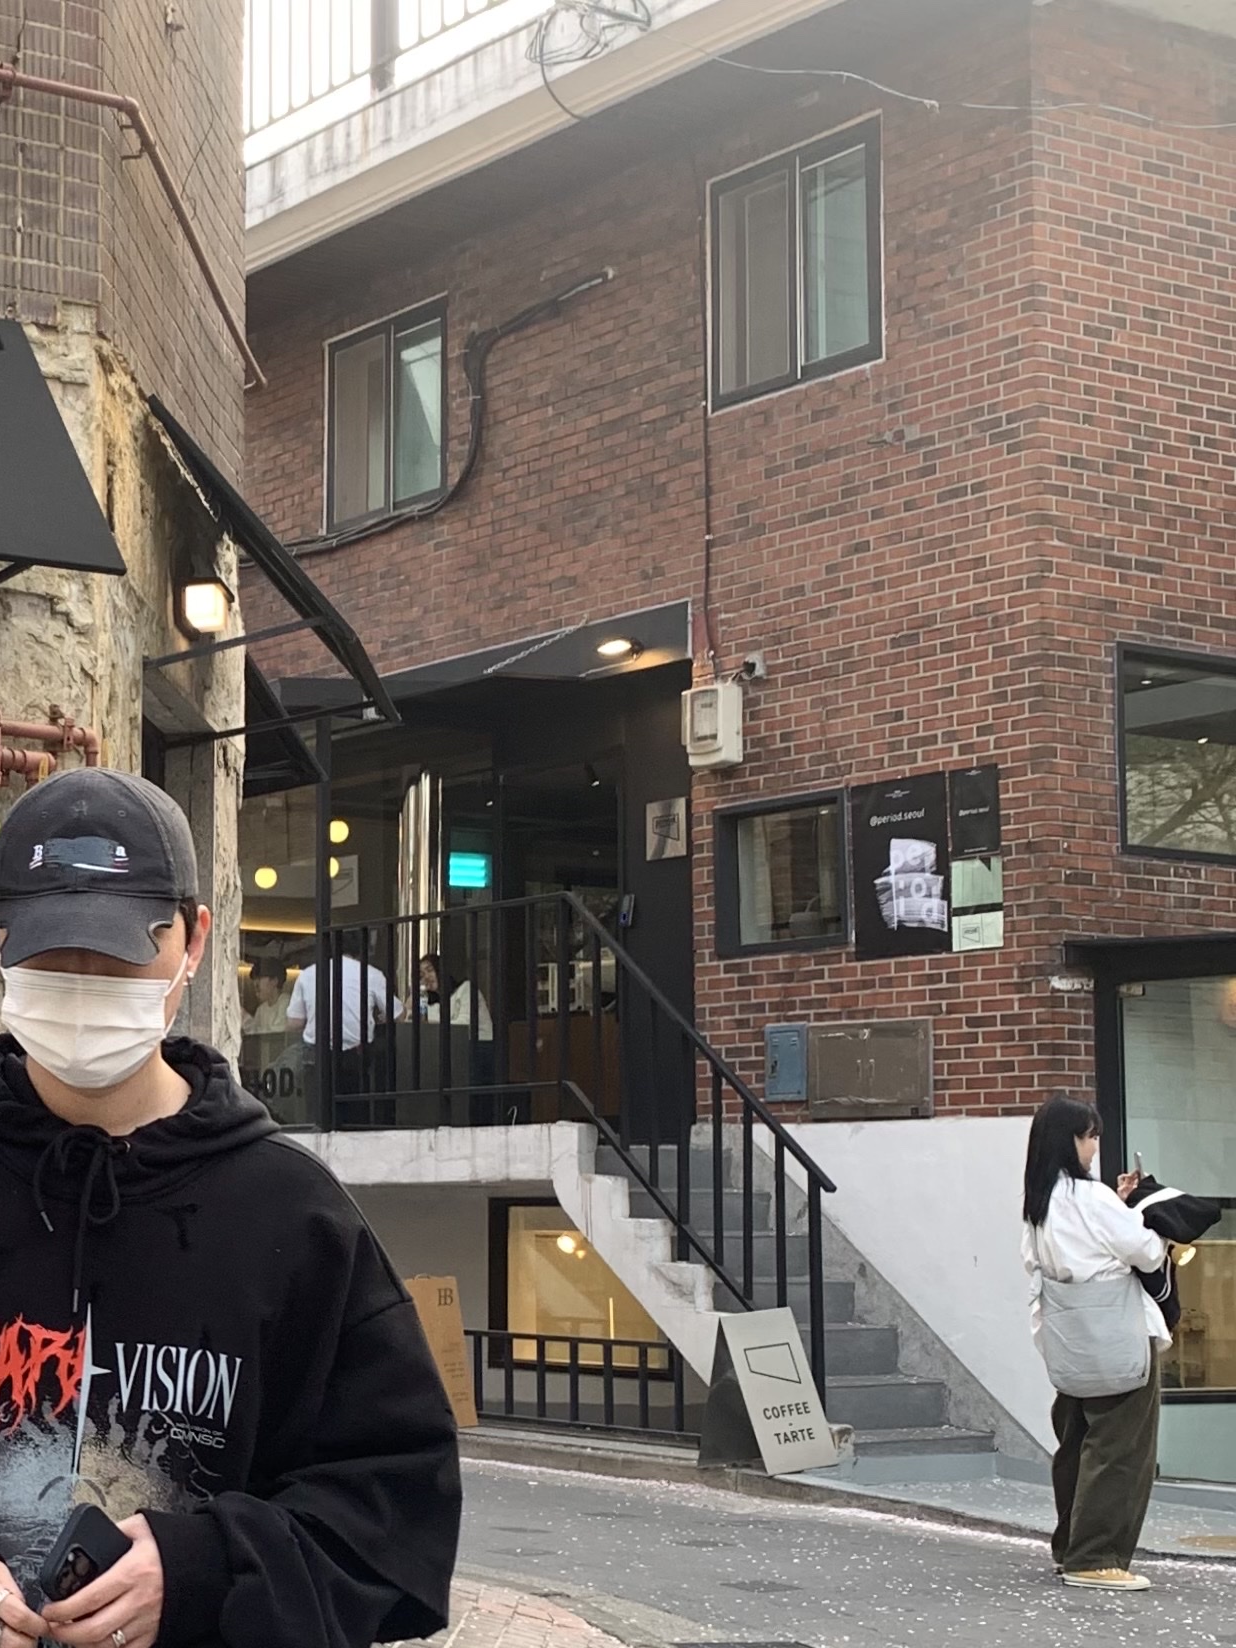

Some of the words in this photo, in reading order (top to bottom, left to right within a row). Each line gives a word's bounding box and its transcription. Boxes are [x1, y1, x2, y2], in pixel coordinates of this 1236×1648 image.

[115, 1341, 243, 1430] VISION
[762, 1401, 812, 1421] COFFEE
[773, 1427, 816, 1446] TARTE
